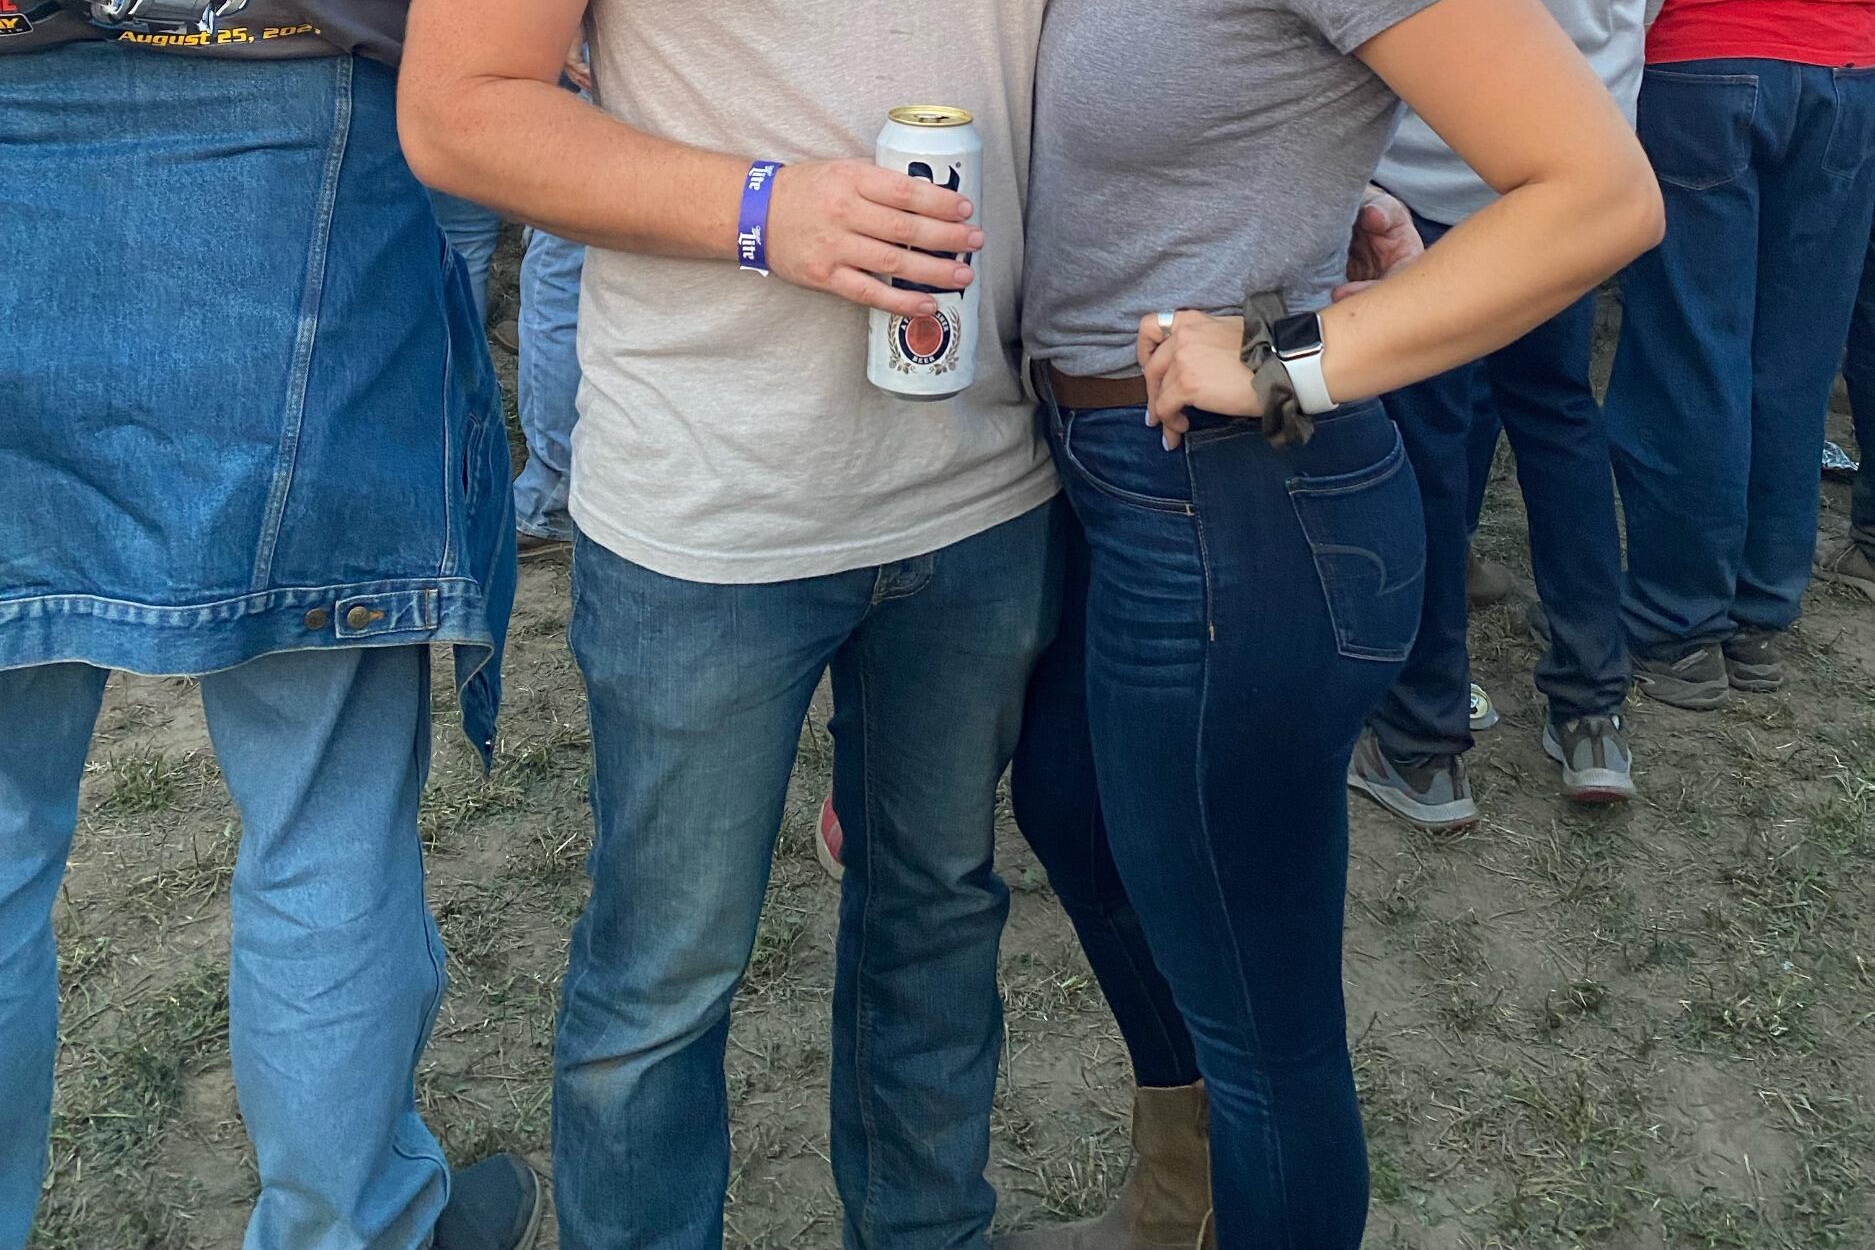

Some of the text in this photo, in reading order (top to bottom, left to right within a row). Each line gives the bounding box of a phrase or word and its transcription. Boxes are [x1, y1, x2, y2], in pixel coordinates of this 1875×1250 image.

[118, 30, 211, 47] August
[217, 27, 255, 45] 25,
[748, 167, 767, 191] Lite
[738, 232, 756, 261] Lite
[911, 355, 936, 364] BEER
